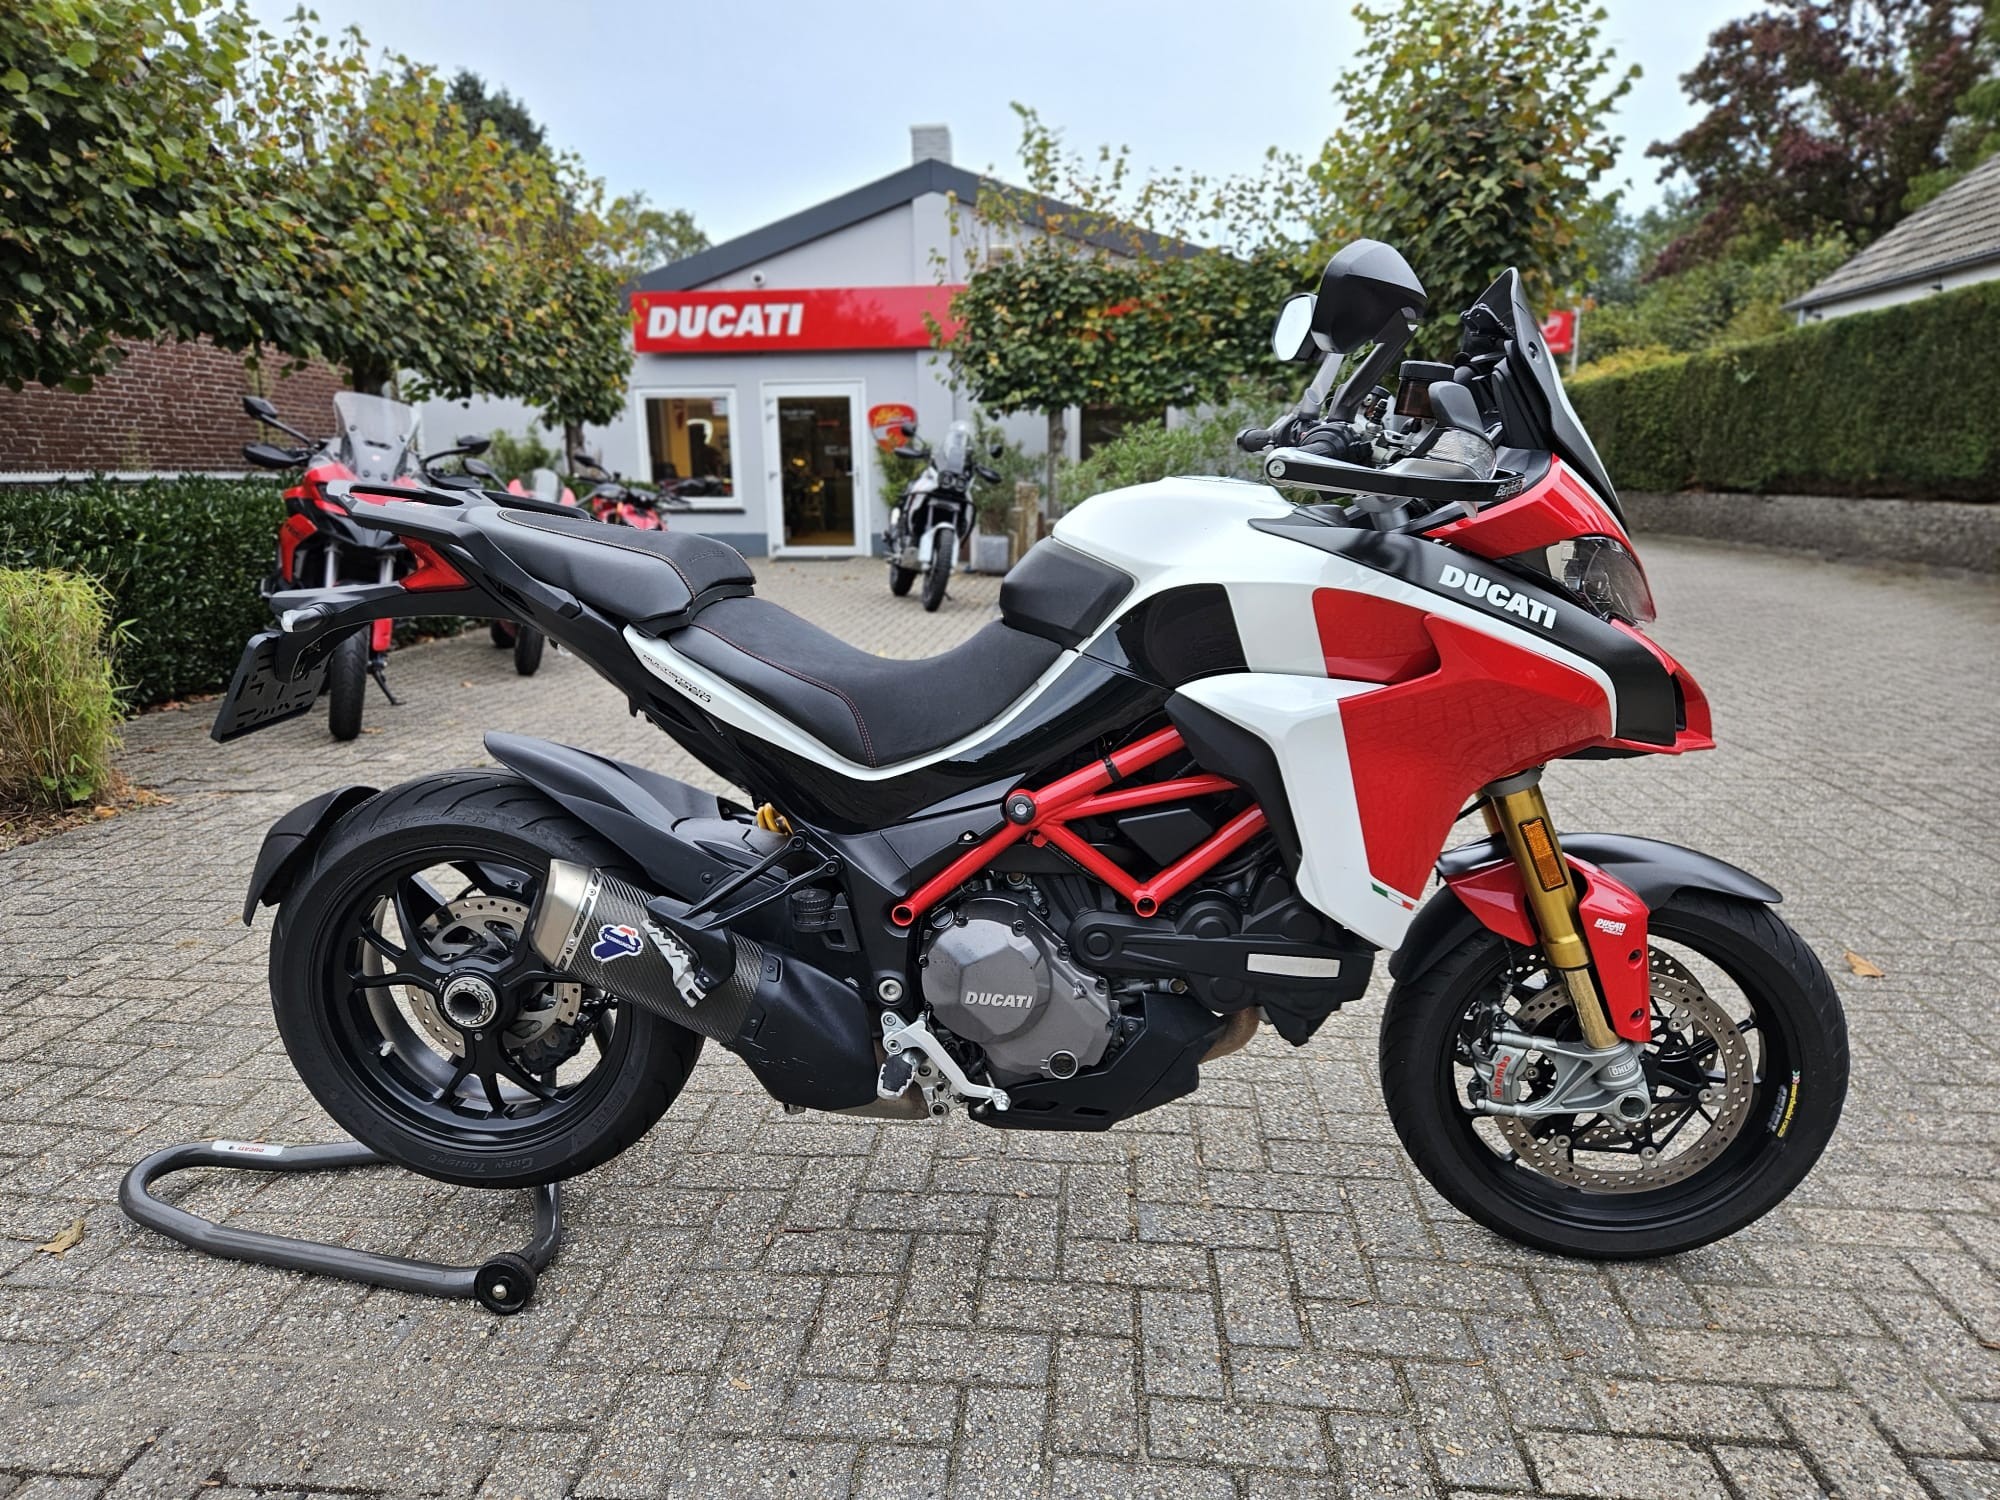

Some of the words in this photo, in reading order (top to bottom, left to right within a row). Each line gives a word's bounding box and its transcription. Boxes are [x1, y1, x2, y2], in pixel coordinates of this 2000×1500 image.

[647, 304, 804, 338] DUCATI
[1438, 564, 1557, 629] DUCATI
[965, 991, 1032, 1008] DUCATI
[1493, 1055, 1511, 1097] brembo
